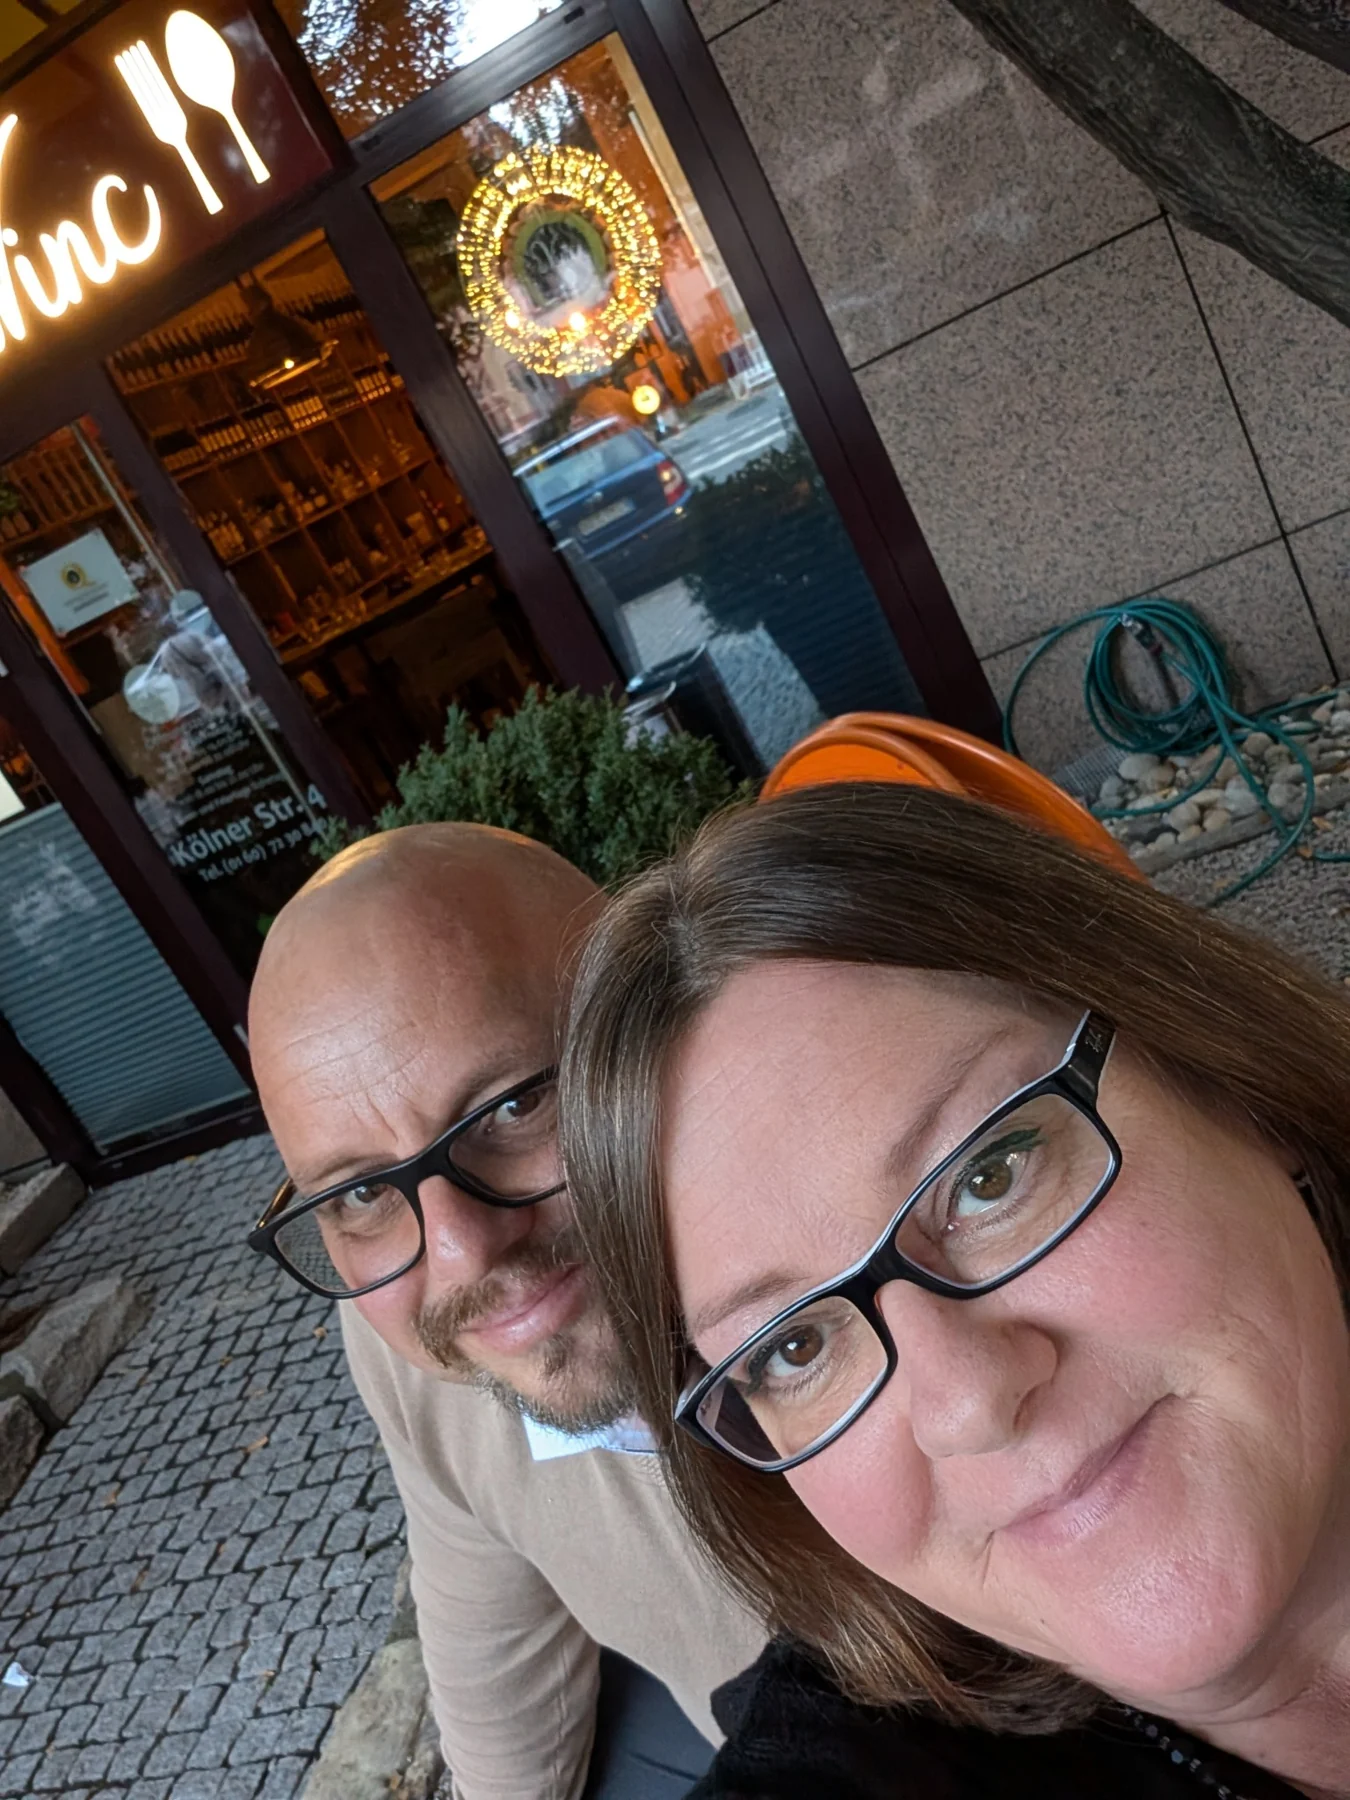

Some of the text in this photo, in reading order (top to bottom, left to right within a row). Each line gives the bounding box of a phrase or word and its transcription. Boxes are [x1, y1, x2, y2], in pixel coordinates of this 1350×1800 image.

[171, 816, 253, 867] Kölner
[253, 796, 304, 829] Str.
[307, 783, 327, 809] 4
